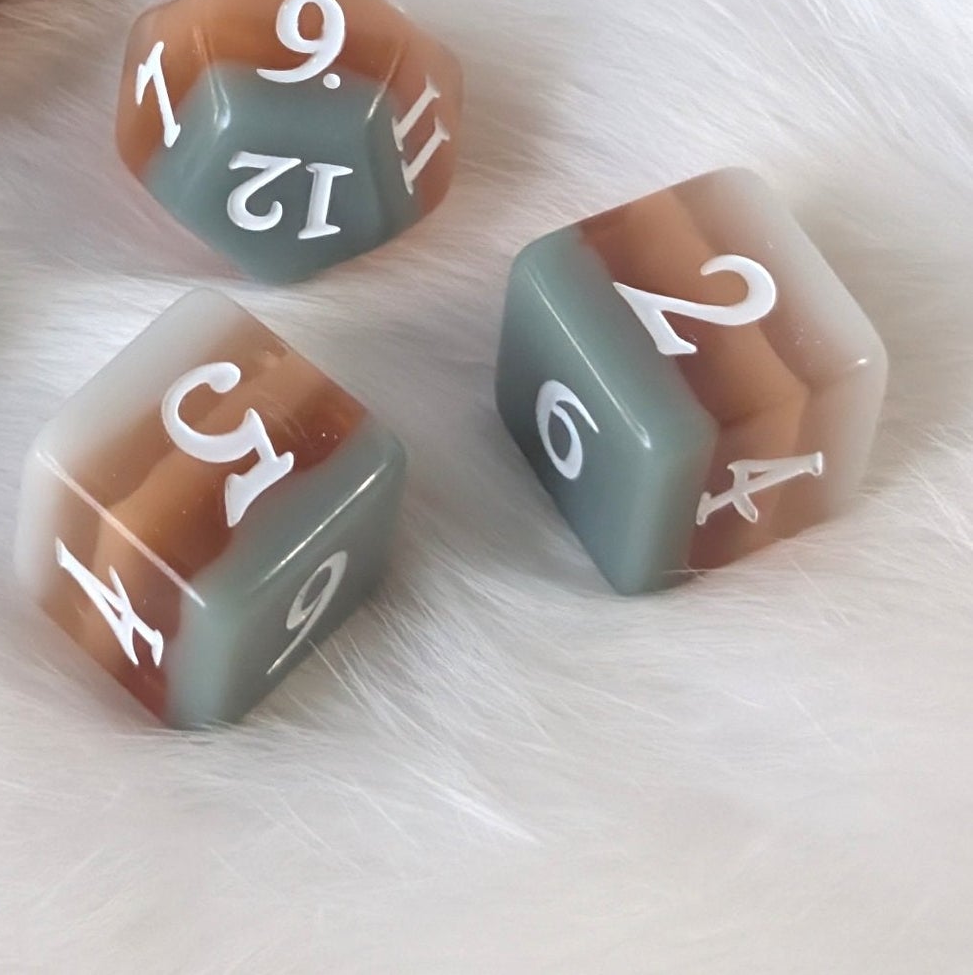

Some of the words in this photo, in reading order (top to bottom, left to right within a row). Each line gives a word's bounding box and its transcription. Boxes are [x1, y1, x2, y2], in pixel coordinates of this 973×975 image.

[391, 76, 451, 196] 11
[226, 150, 354, 240] 12
[612, 254, 778, 356] 2
[160, 361, 295, 527] 5
[695, 451, 825, 525] 4
[55, 537, 164, 667] 4
